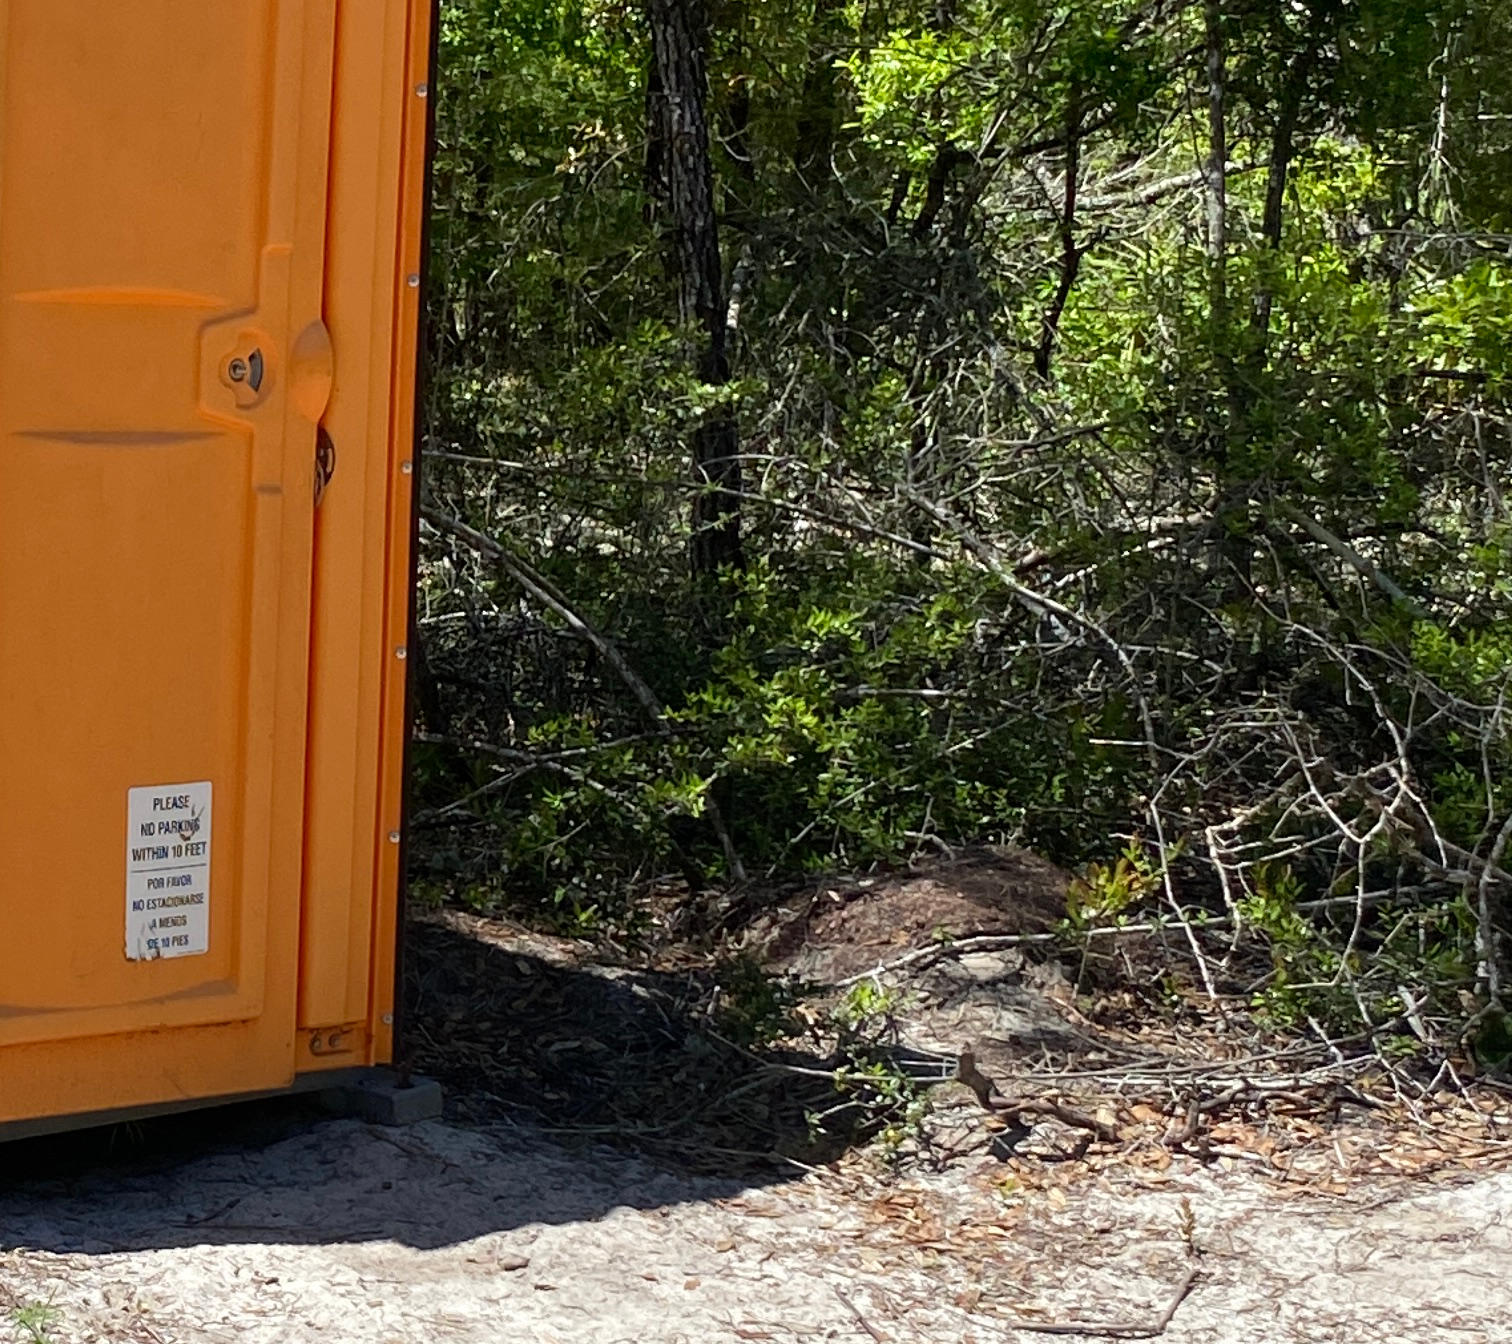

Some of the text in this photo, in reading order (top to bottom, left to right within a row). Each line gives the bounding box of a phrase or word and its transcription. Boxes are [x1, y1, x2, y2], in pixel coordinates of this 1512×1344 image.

[153, 795, 190, 811] PLEASE
[141, 818, 200, 836] NO PARKING
[132, 841, 207, 861] WITHIN 10 FEET
[148, 874, 192, 890] POR FAVOR
[132, 893, 204, 912] NO ESTACIONARSE
[152, 915, 187, 929] A MENOS
[162, 937, 170, 947] 10
[172, 934, 189, 947] PIES
